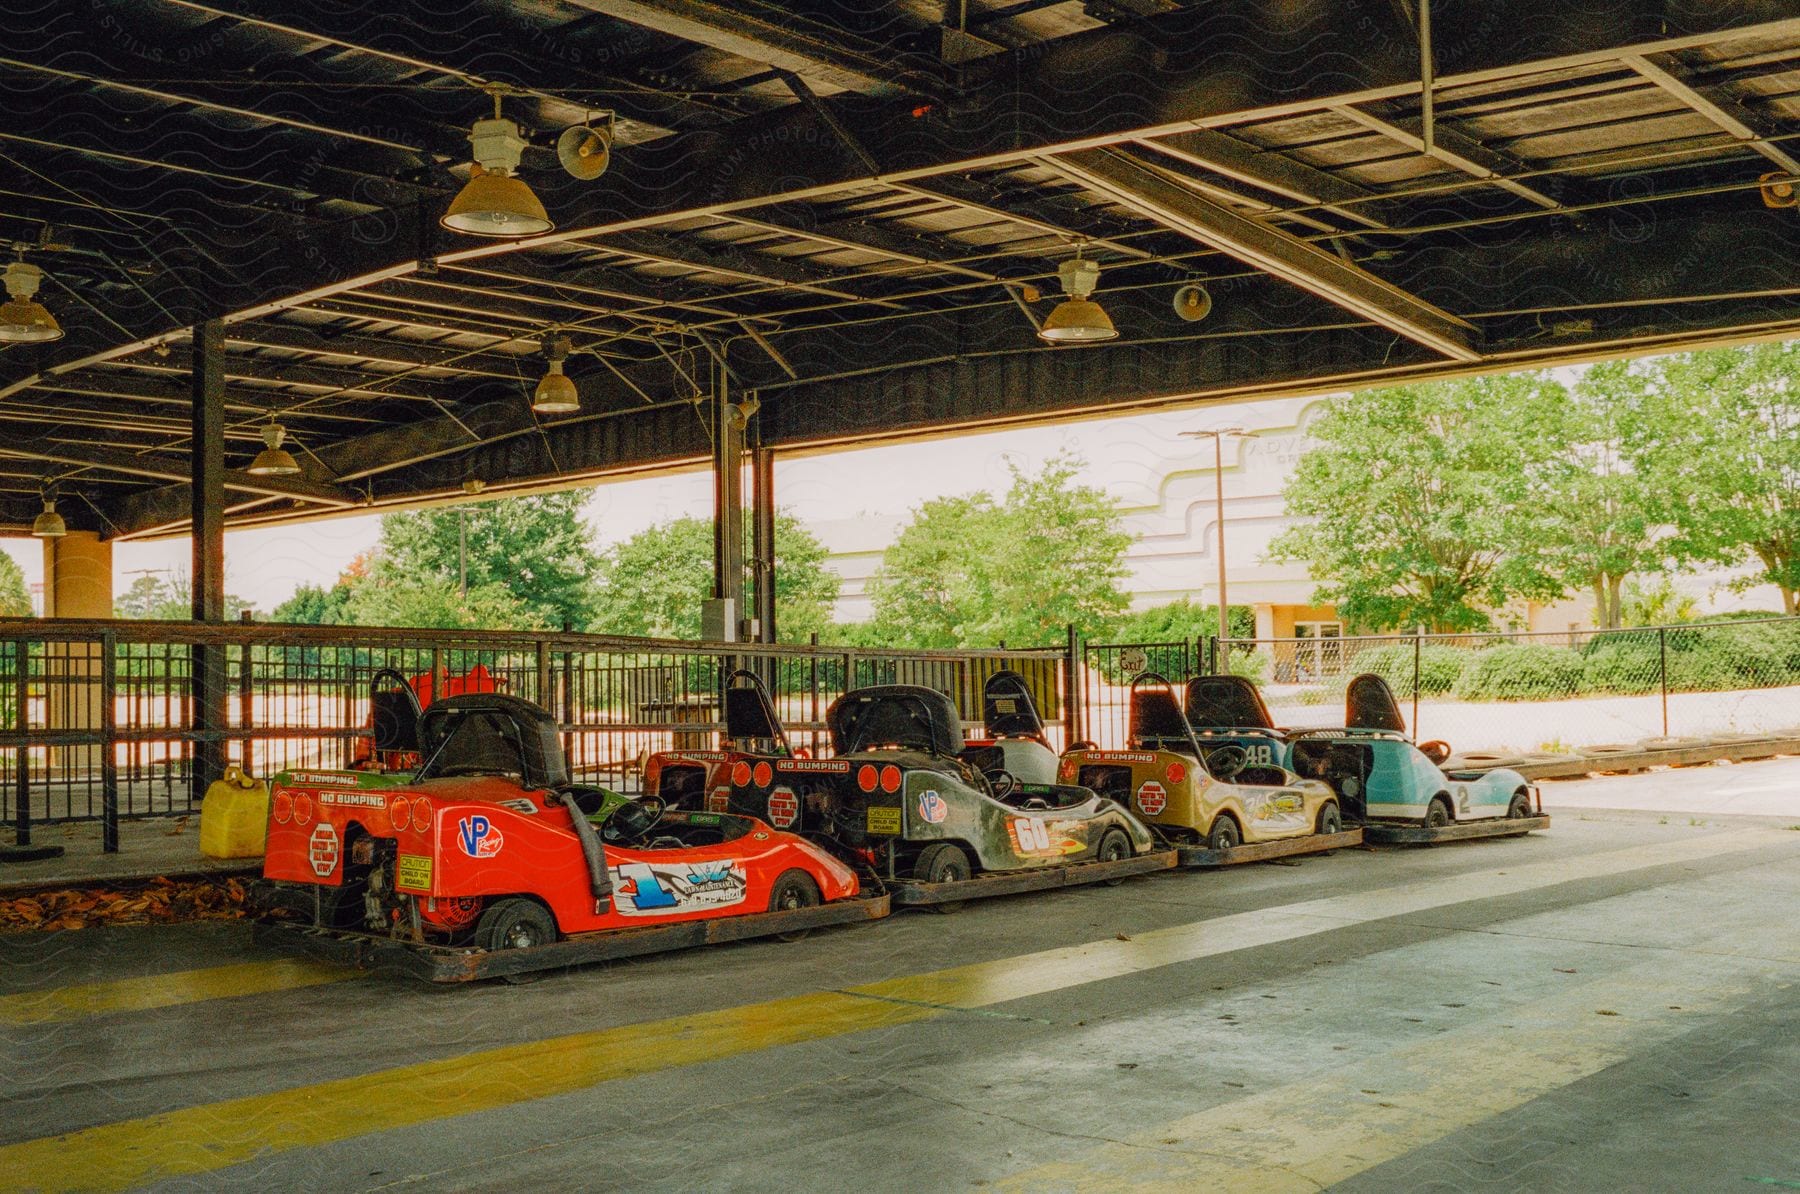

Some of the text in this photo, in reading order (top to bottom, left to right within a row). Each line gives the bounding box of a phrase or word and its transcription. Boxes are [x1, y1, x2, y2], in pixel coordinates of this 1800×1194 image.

[1120, 651, 1144, 672] Exit
[1104, 754, 1153, 762] BUMPING
[780, 761, 846, 771] NO BUMPING
[294, 774, 354, 785] NO BUMPING
[321, 793, 384, 806] NO BUMPING
[1457, 785, 1471, 814] 2
[458, 815, 490, 857] VP
[1014, 817, 1050, 851] 60
[401, 858, 430, 869] CAUTION
[404, 878, 425, 886] BOARD
[616, 862, 678, 911] 1
